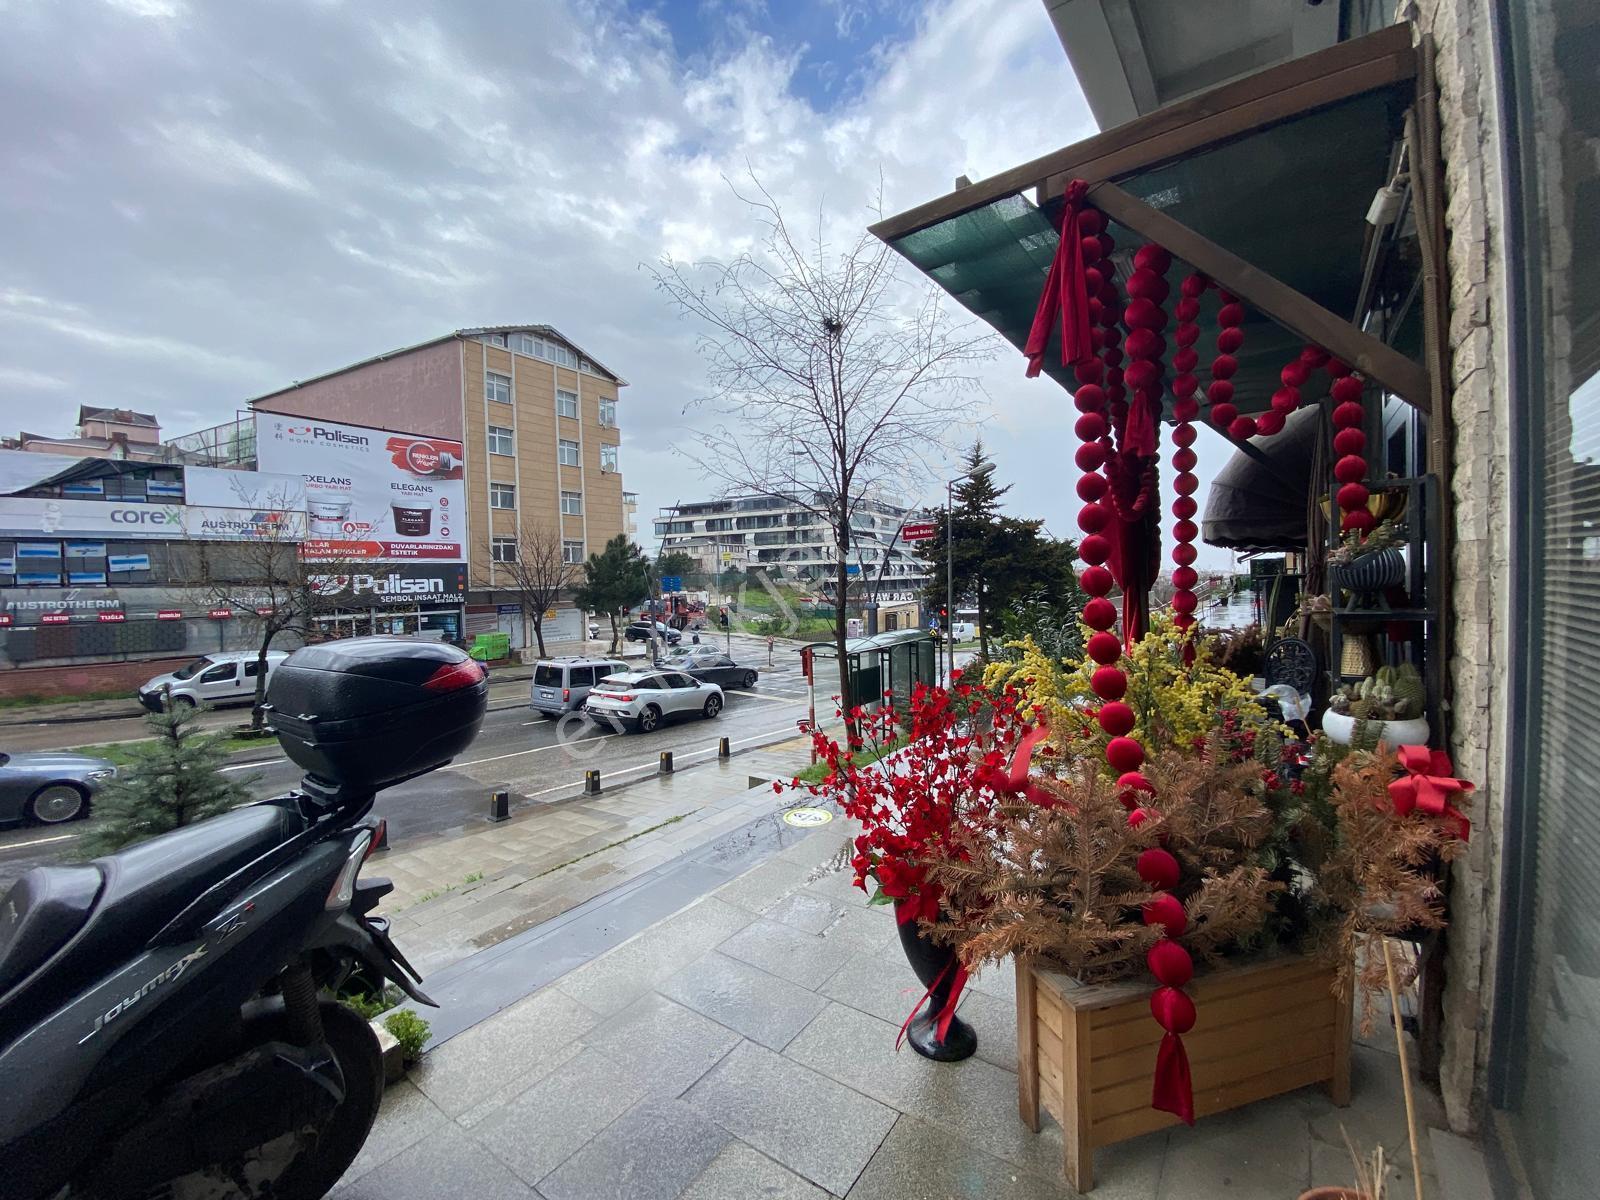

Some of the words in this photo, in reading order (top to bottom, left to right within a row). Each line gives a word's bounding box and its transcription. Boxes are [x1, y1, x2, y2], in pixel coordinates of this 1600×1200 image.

[313, 427, 369, 446] Polisan
[320, 441, 370, 452] COSMETICS
[390, 483, 433, 492] ELEGANS
[201, 520, 289, 531] AUSTROTHERM
[352, 574, 444, 594] Polisan
[380, 595, 413, 603] SEMBOL
[6, 600, 120, 610] AUSTROTHERM
